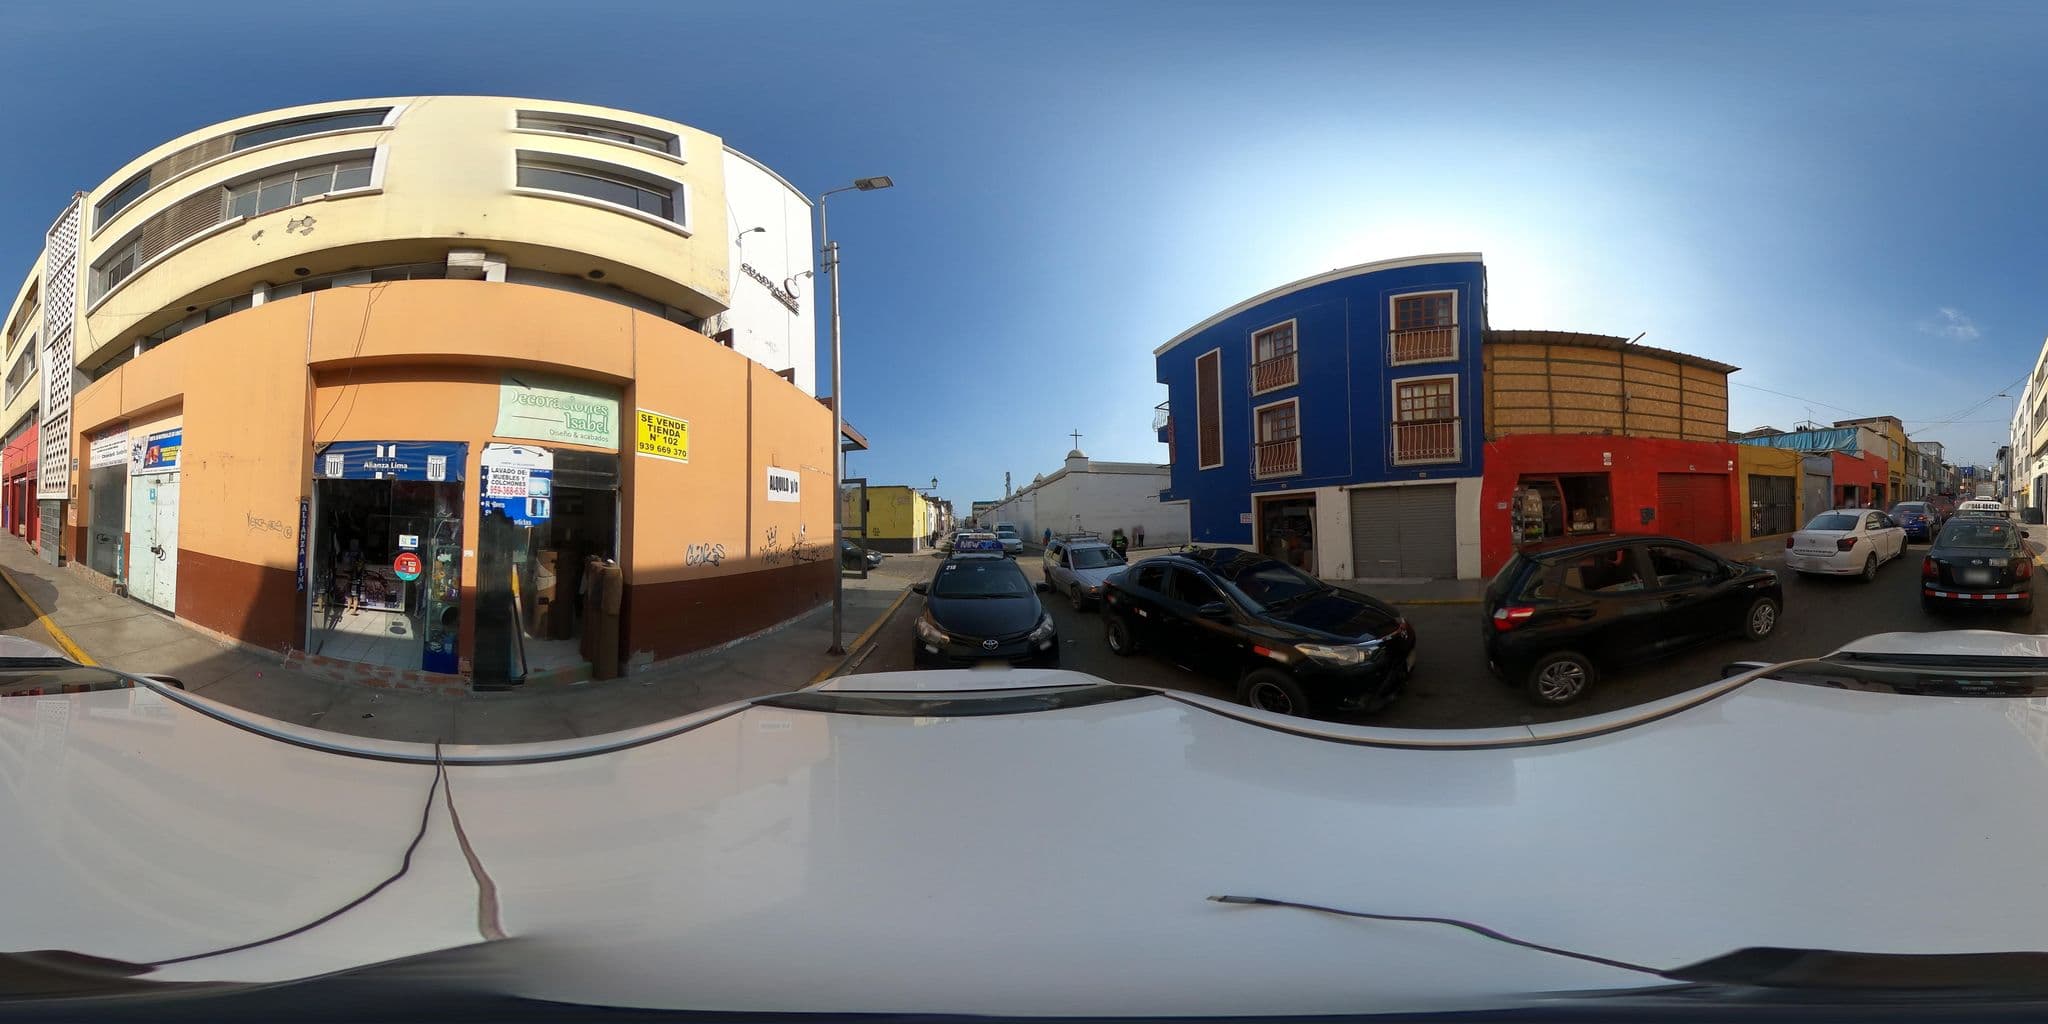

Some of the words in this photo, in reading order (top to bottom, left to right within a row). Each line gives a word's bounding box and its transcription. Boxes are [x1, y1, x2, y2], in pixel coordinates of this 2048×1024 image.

[564, 412, 609, 434] Isabel
[641, 414, 653, 424] SE
[656, 417, 686, 431] VENDE
[647, 424, 681, 438] TIENDA
[663, 436, 678, 446] 102
[639, 442, 655, 451] 939
[657, 445, 671, 454] 669
[673, 449, 687, 457] 370
[363, 461, 389, 469] Alianza
[390, 461, 408, 469] Lima
[769, 474, 789, 493] ALQUILO
[300, 504, 308, 555] ALIANZA
